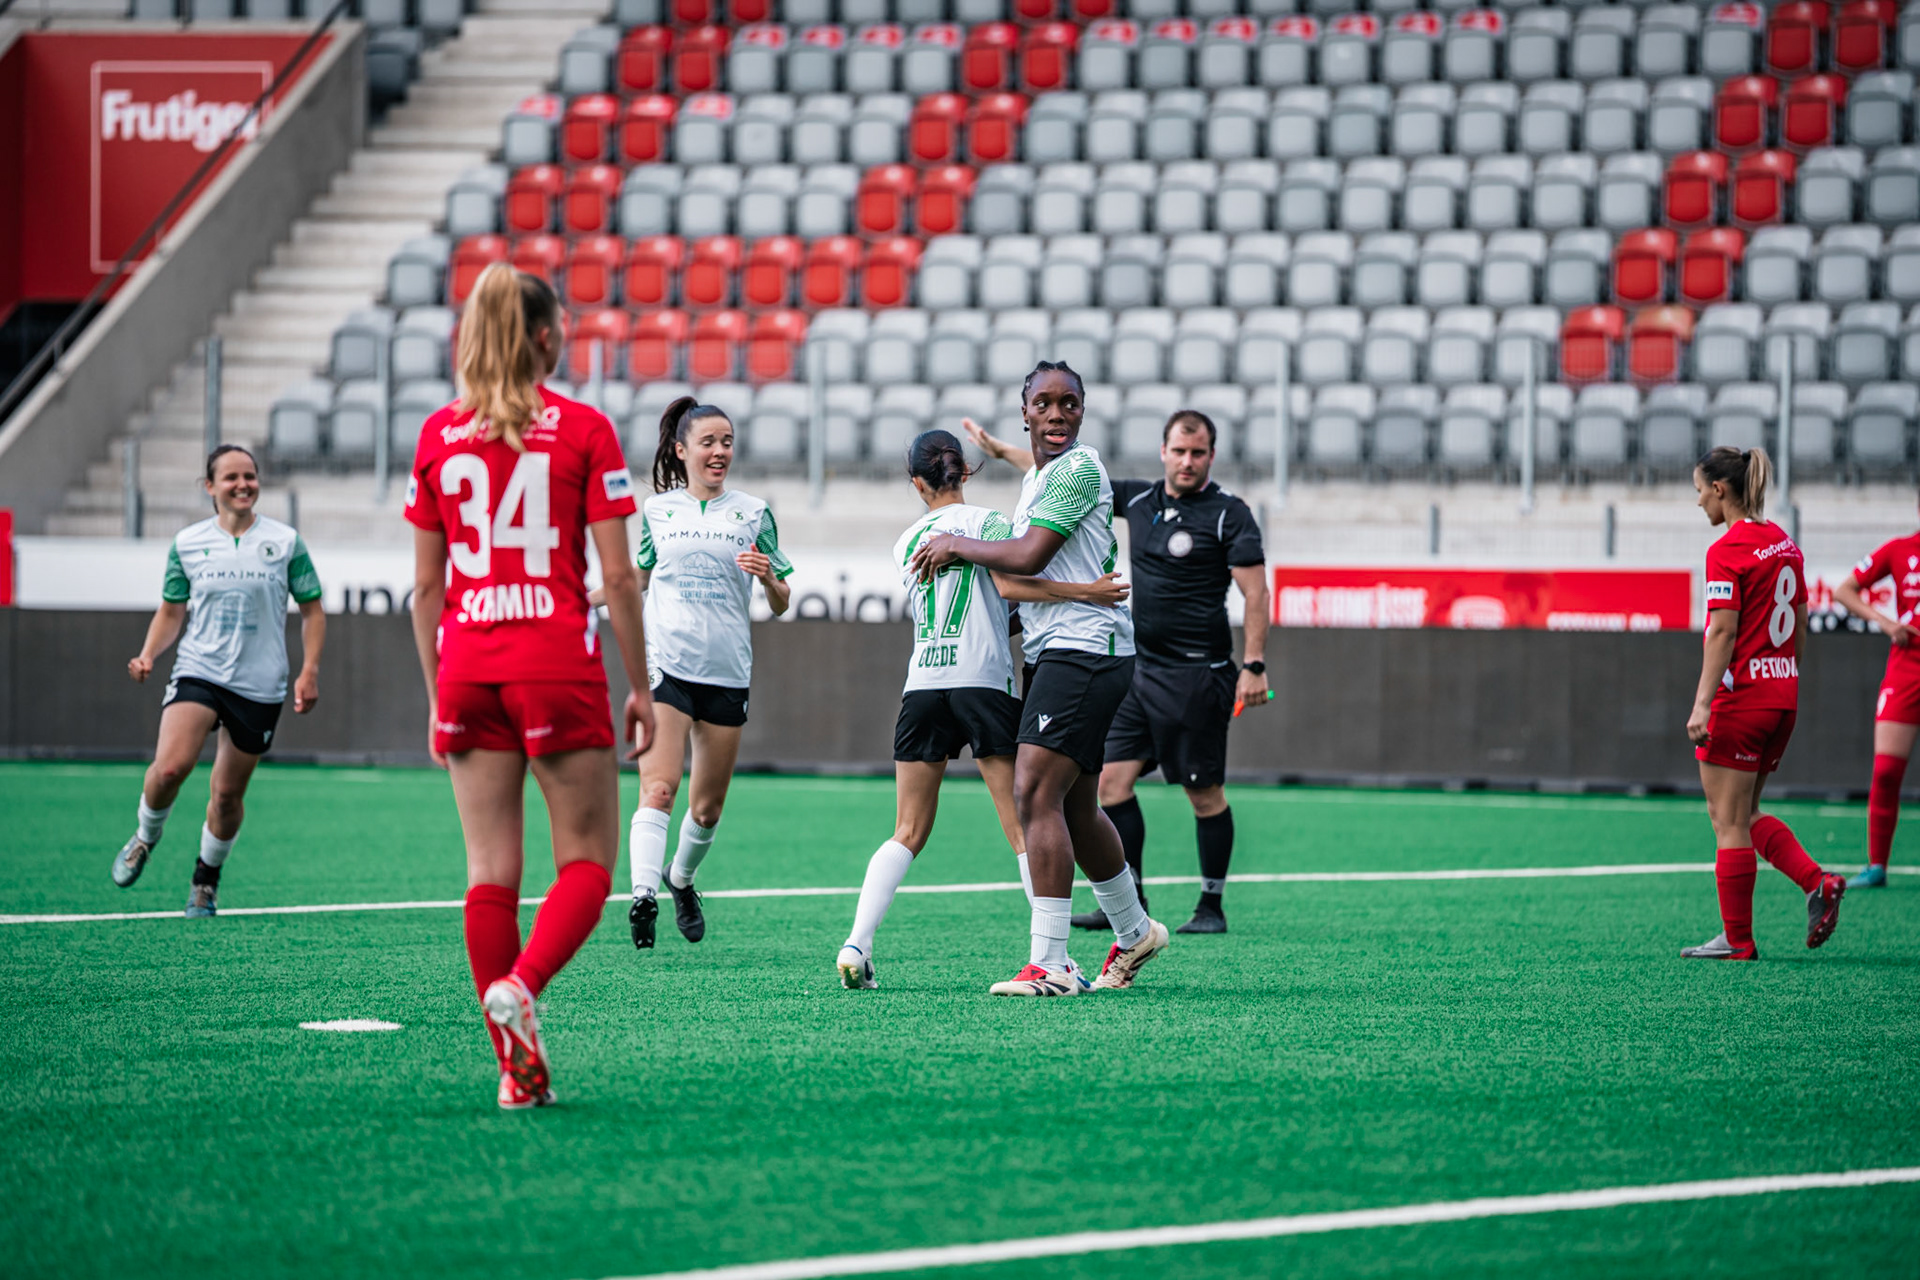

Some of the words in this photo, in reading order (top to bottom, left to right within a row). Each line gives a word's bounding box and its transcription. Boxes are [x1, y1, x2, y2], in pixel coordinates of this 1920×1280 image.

[440, 452, 560, 579] 34
[916, 557, 977, 643] 17
[1768, 565, 1797, 648] 8
